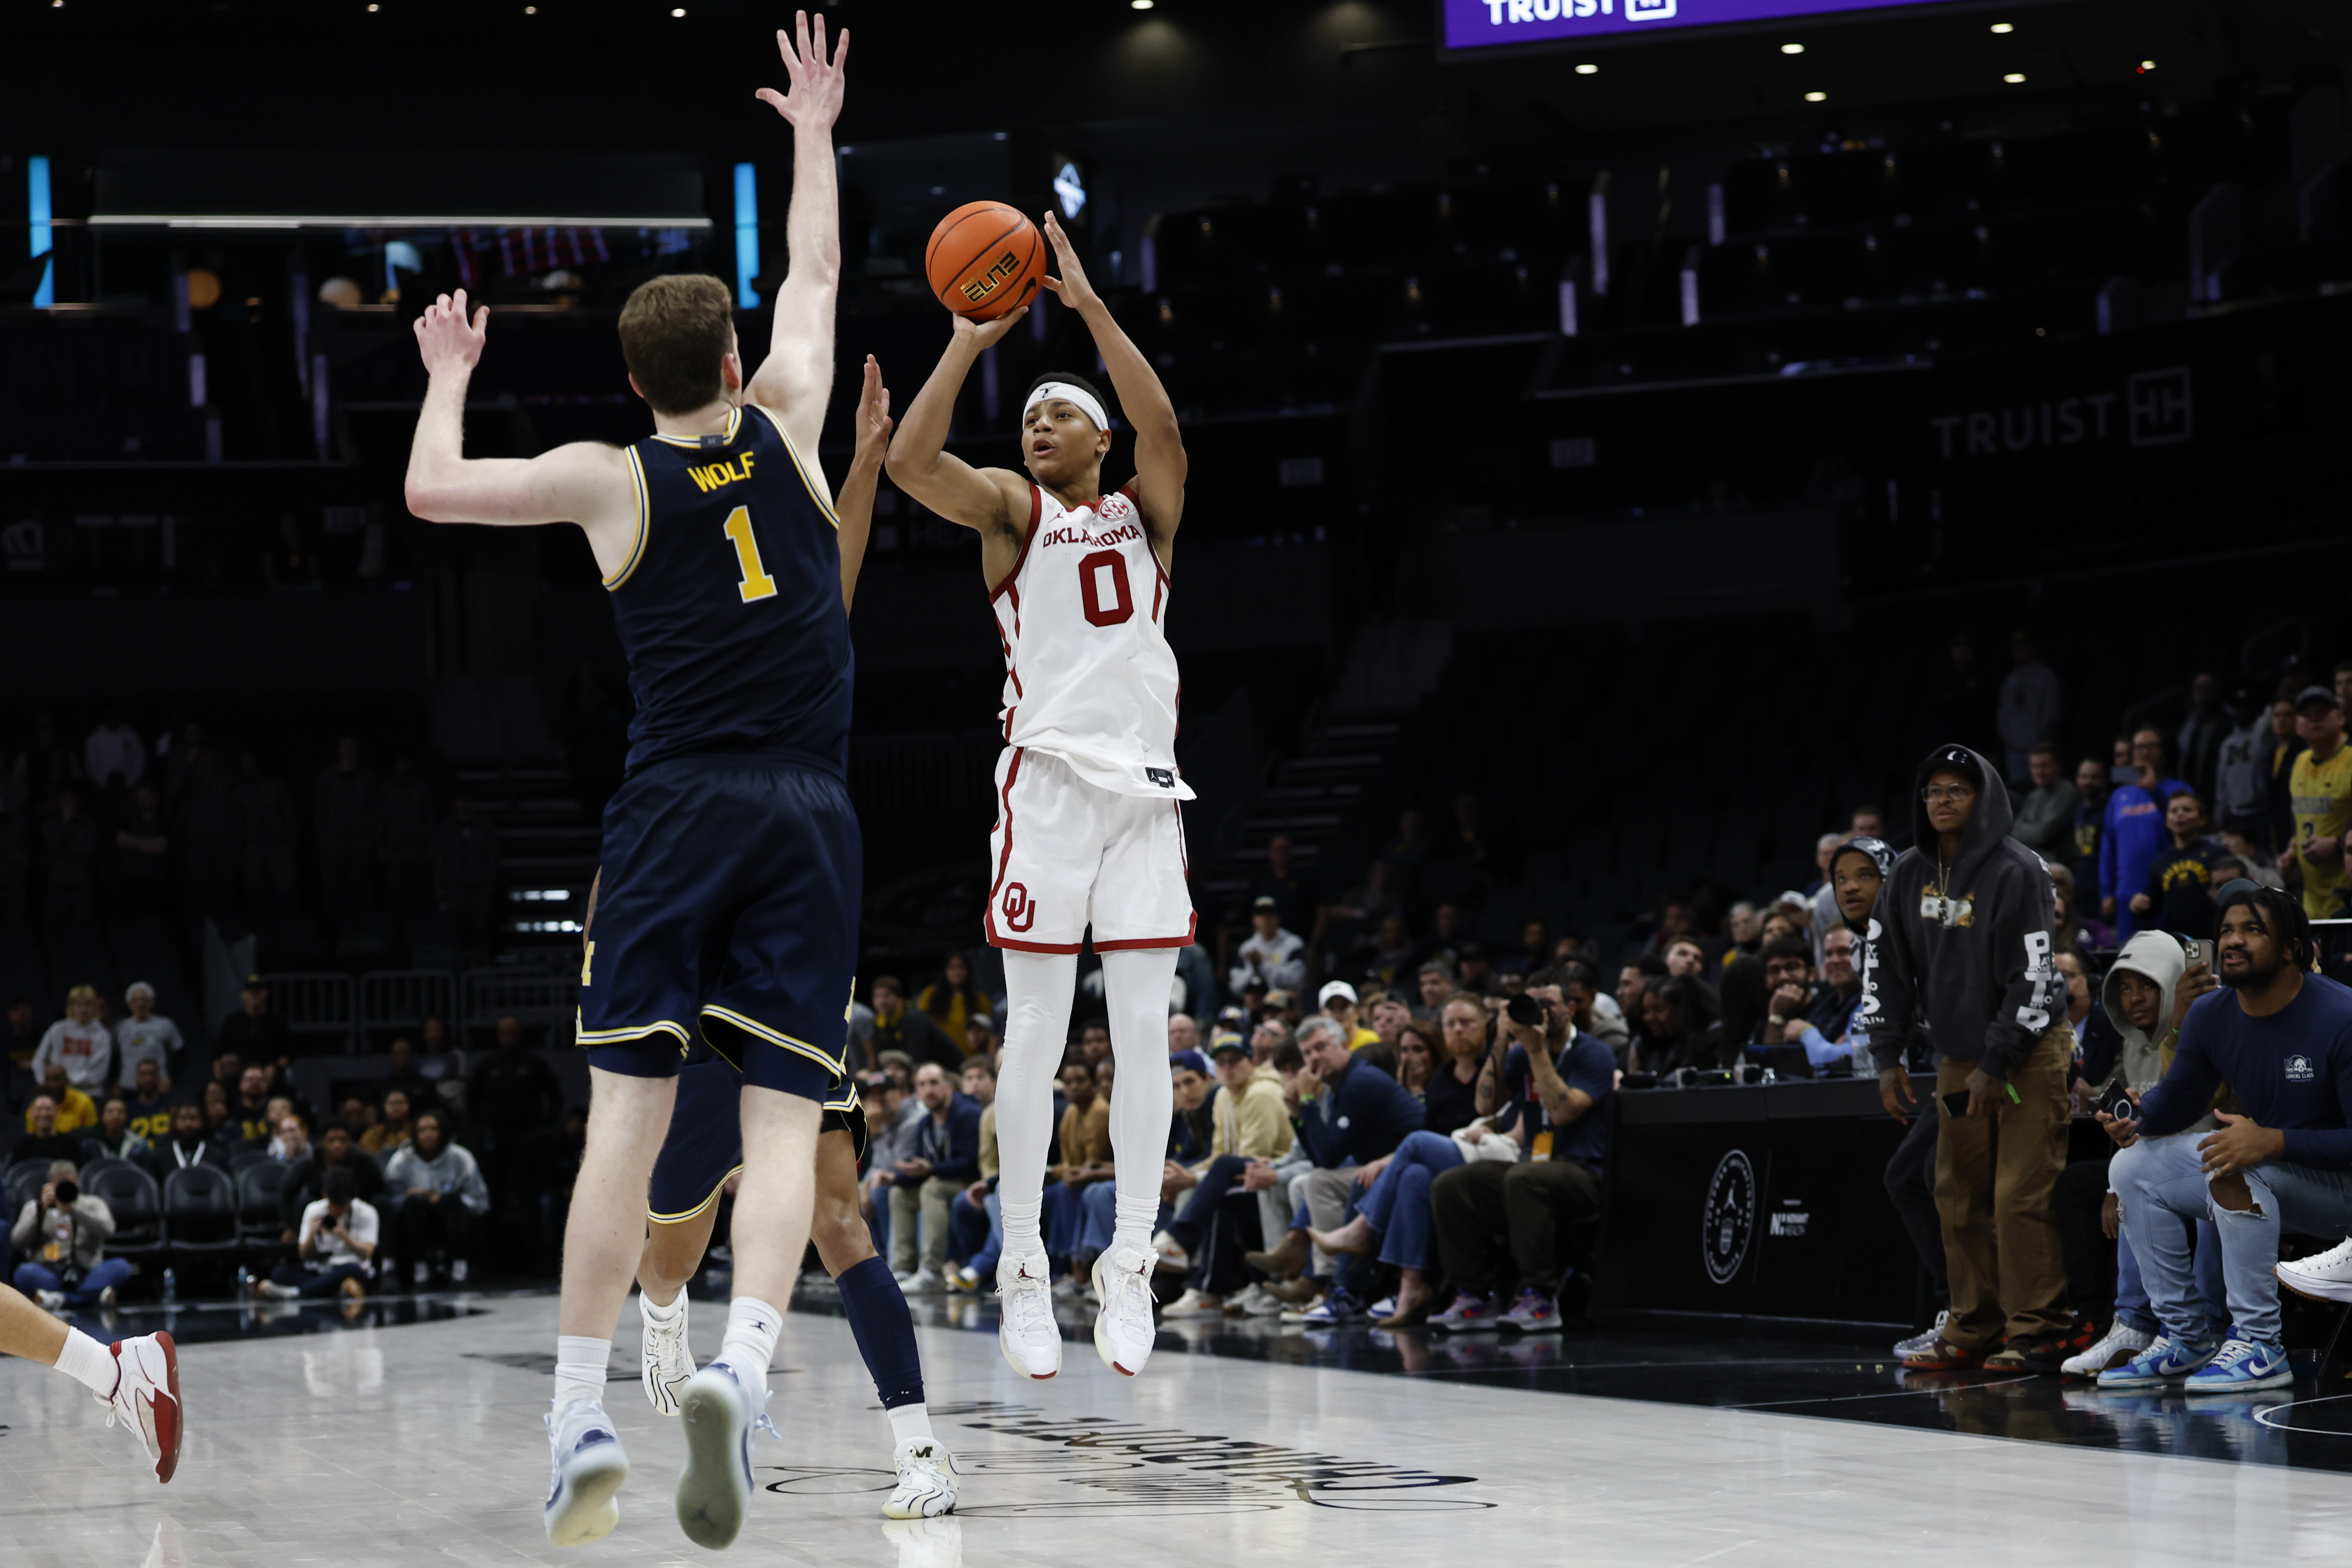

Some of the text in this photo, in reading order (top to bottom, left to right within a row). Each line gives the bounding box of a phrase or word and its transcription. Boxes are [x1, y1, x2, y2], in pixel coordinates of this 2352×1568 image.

[963, 250, 1020, 303] ELITE
[1930, 391, 2116, 460] TRUIST
[687, 451, 754, 492] WOLF
[1102, 500, 1127, 518] SEC
[723, 504, 778, 603] 1
[1043, 525, 1143, 548] OKLAHOMA
[1078, 549, 1134, 627] 0
[1002, 882, 1036, 932] OU
